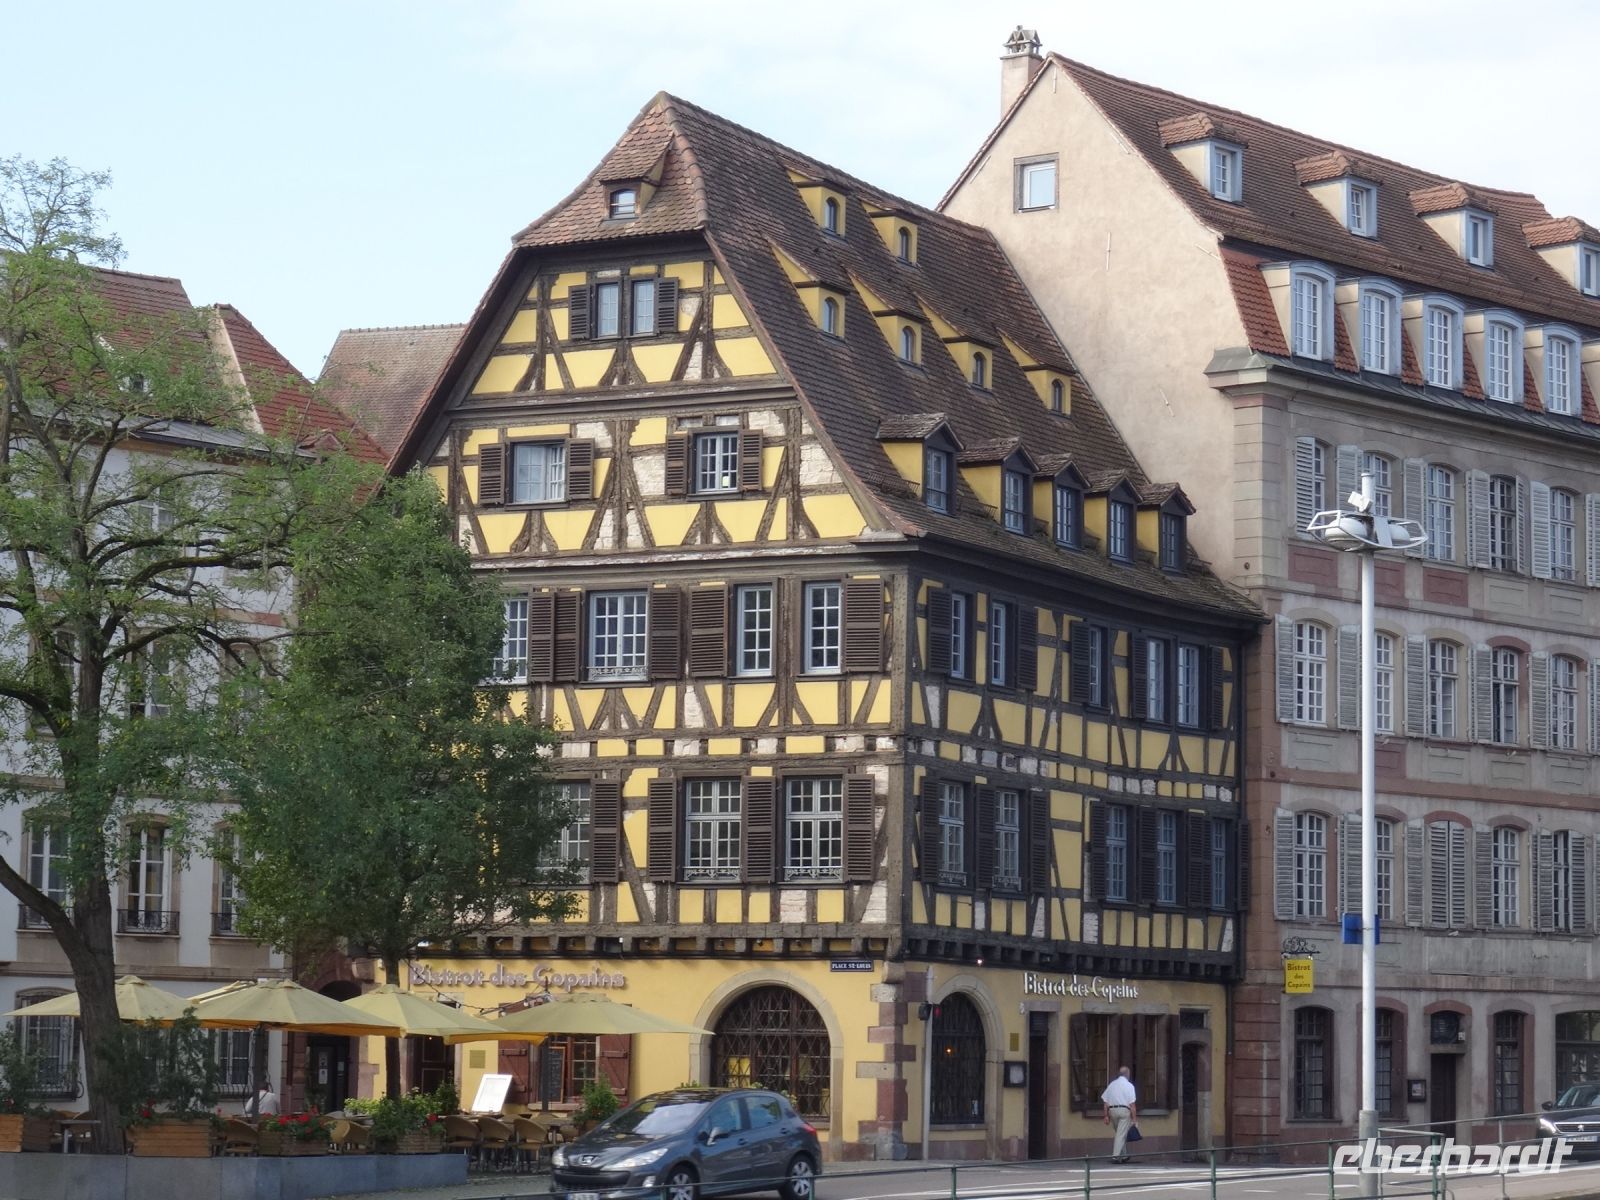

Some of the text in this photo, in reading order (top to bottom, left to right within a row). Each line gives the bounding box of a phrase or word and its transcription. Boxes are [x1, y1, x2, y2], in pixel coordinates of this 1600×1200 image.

[1287, 963, 1311, 971] Bistrot
[409, 963, 626, 992] Bistrot des Copains
[1287, 981, 1311, 989] Copains
[1024, 972, 1139, 1003] Bistrot des Copains
